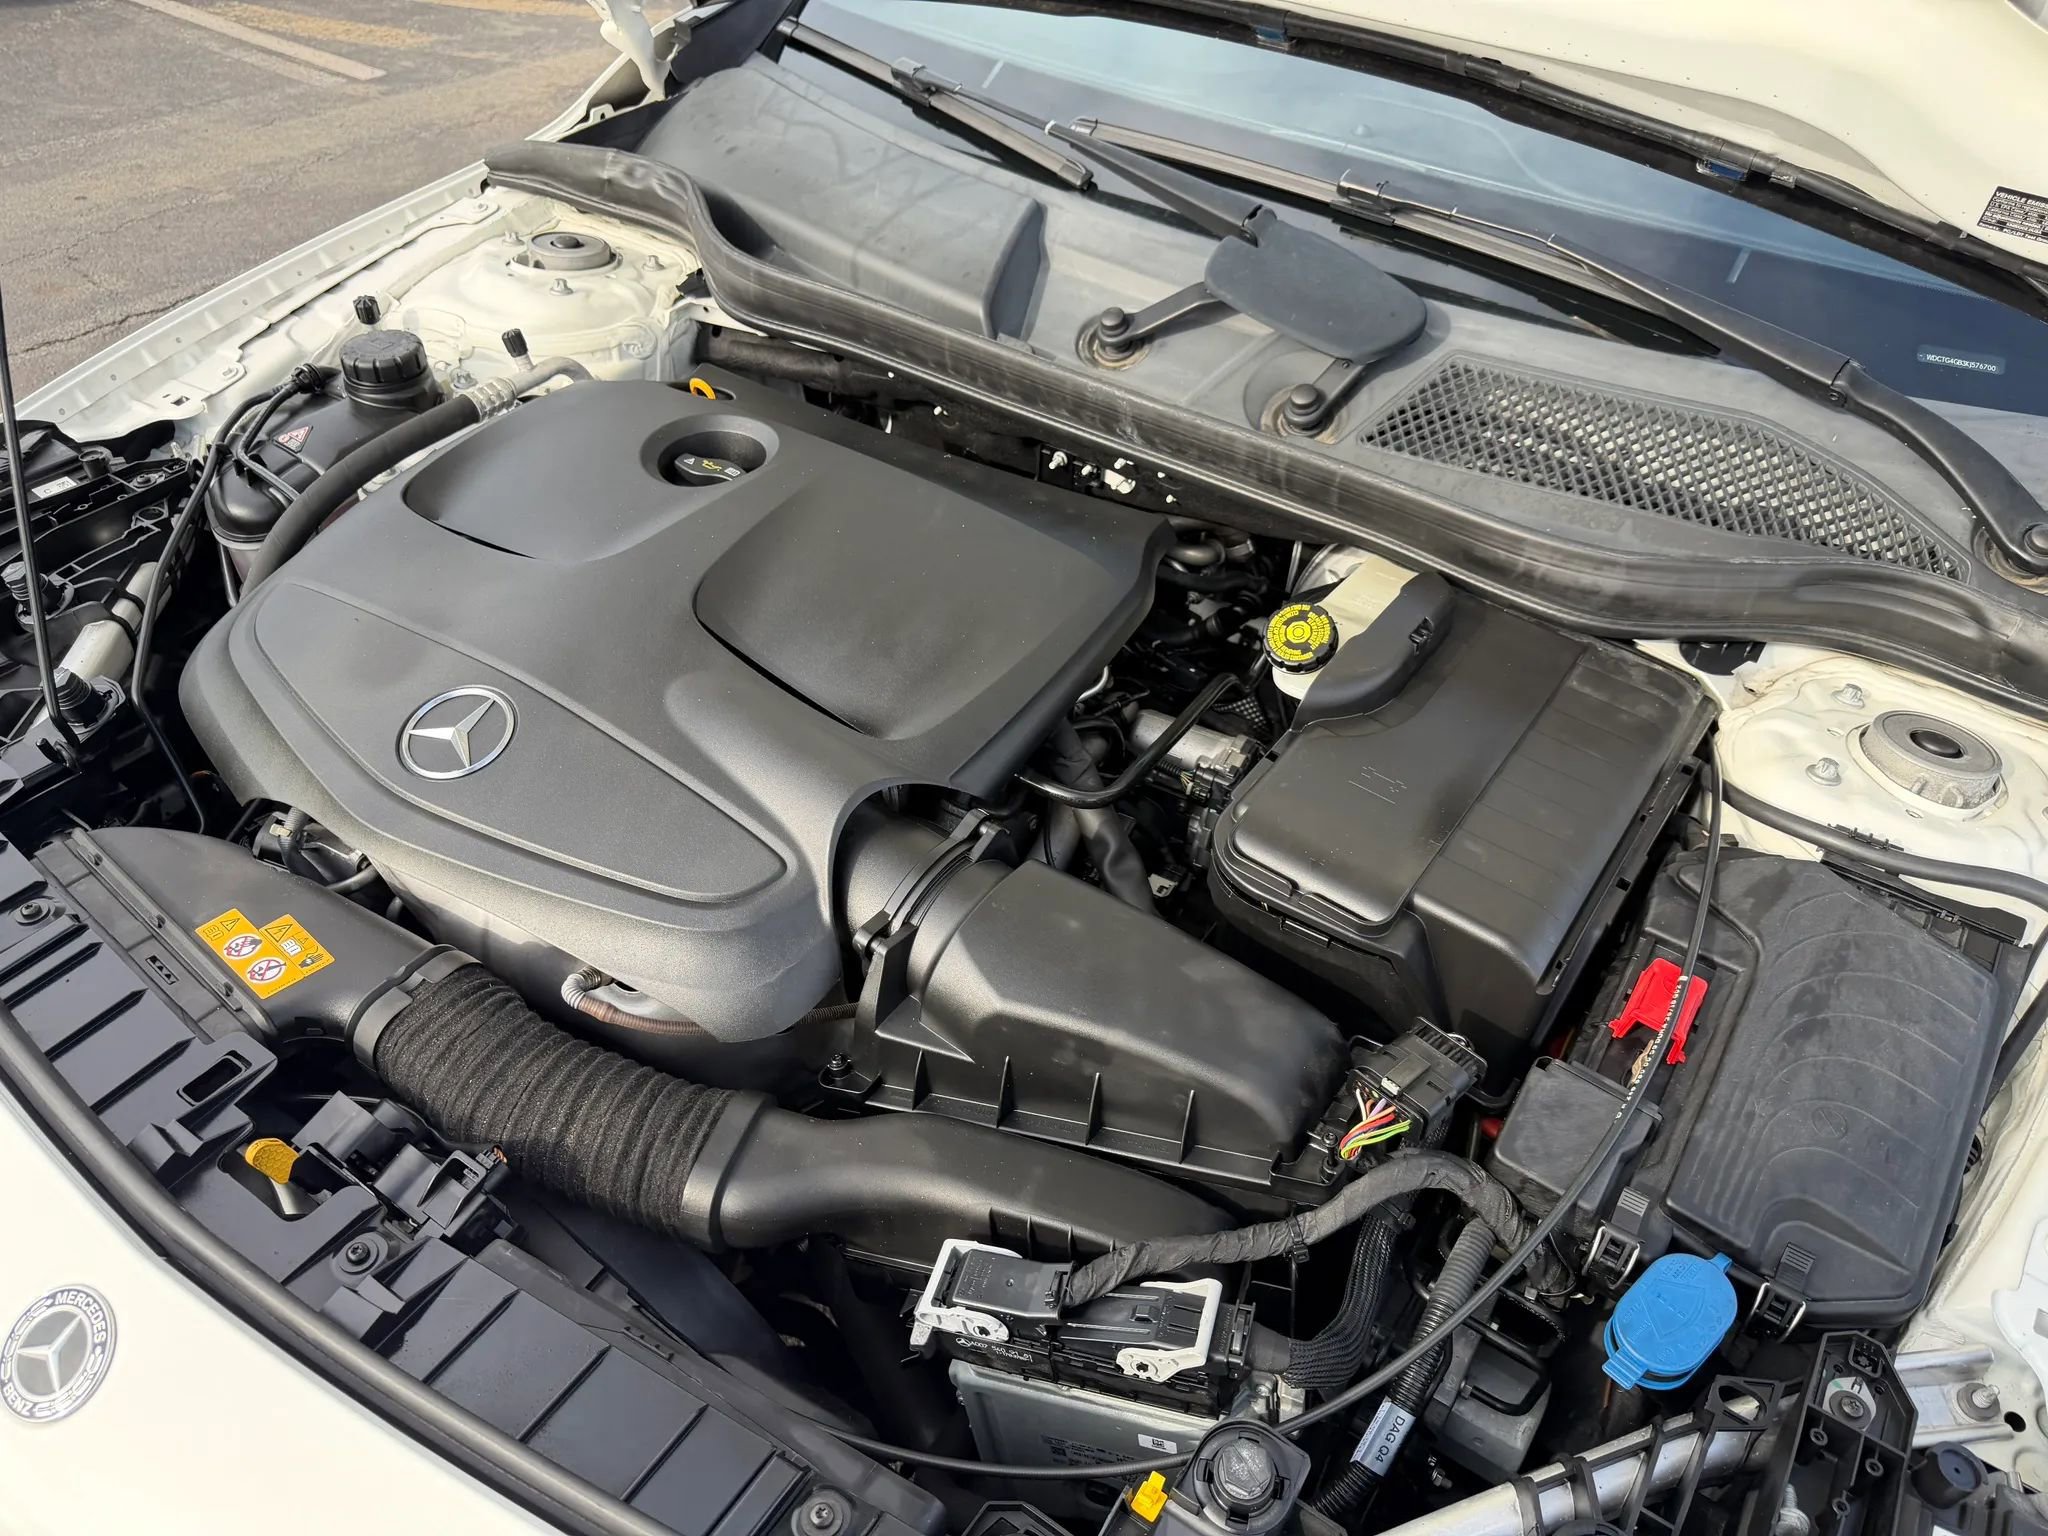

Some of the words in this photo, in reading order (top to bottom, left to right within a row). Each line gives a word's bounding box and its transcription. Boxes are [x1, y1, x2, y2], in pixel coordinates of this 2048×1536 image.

[1996, 191, 2027, 203] VEHICLE
[54, 1290, 107, 1344] MERCEDES
[3, 1382, 34, 1416] BENZ
[1384, 1415, 1406, 1444] DAG
[1375, 1445, 1390, 1463] Q4
